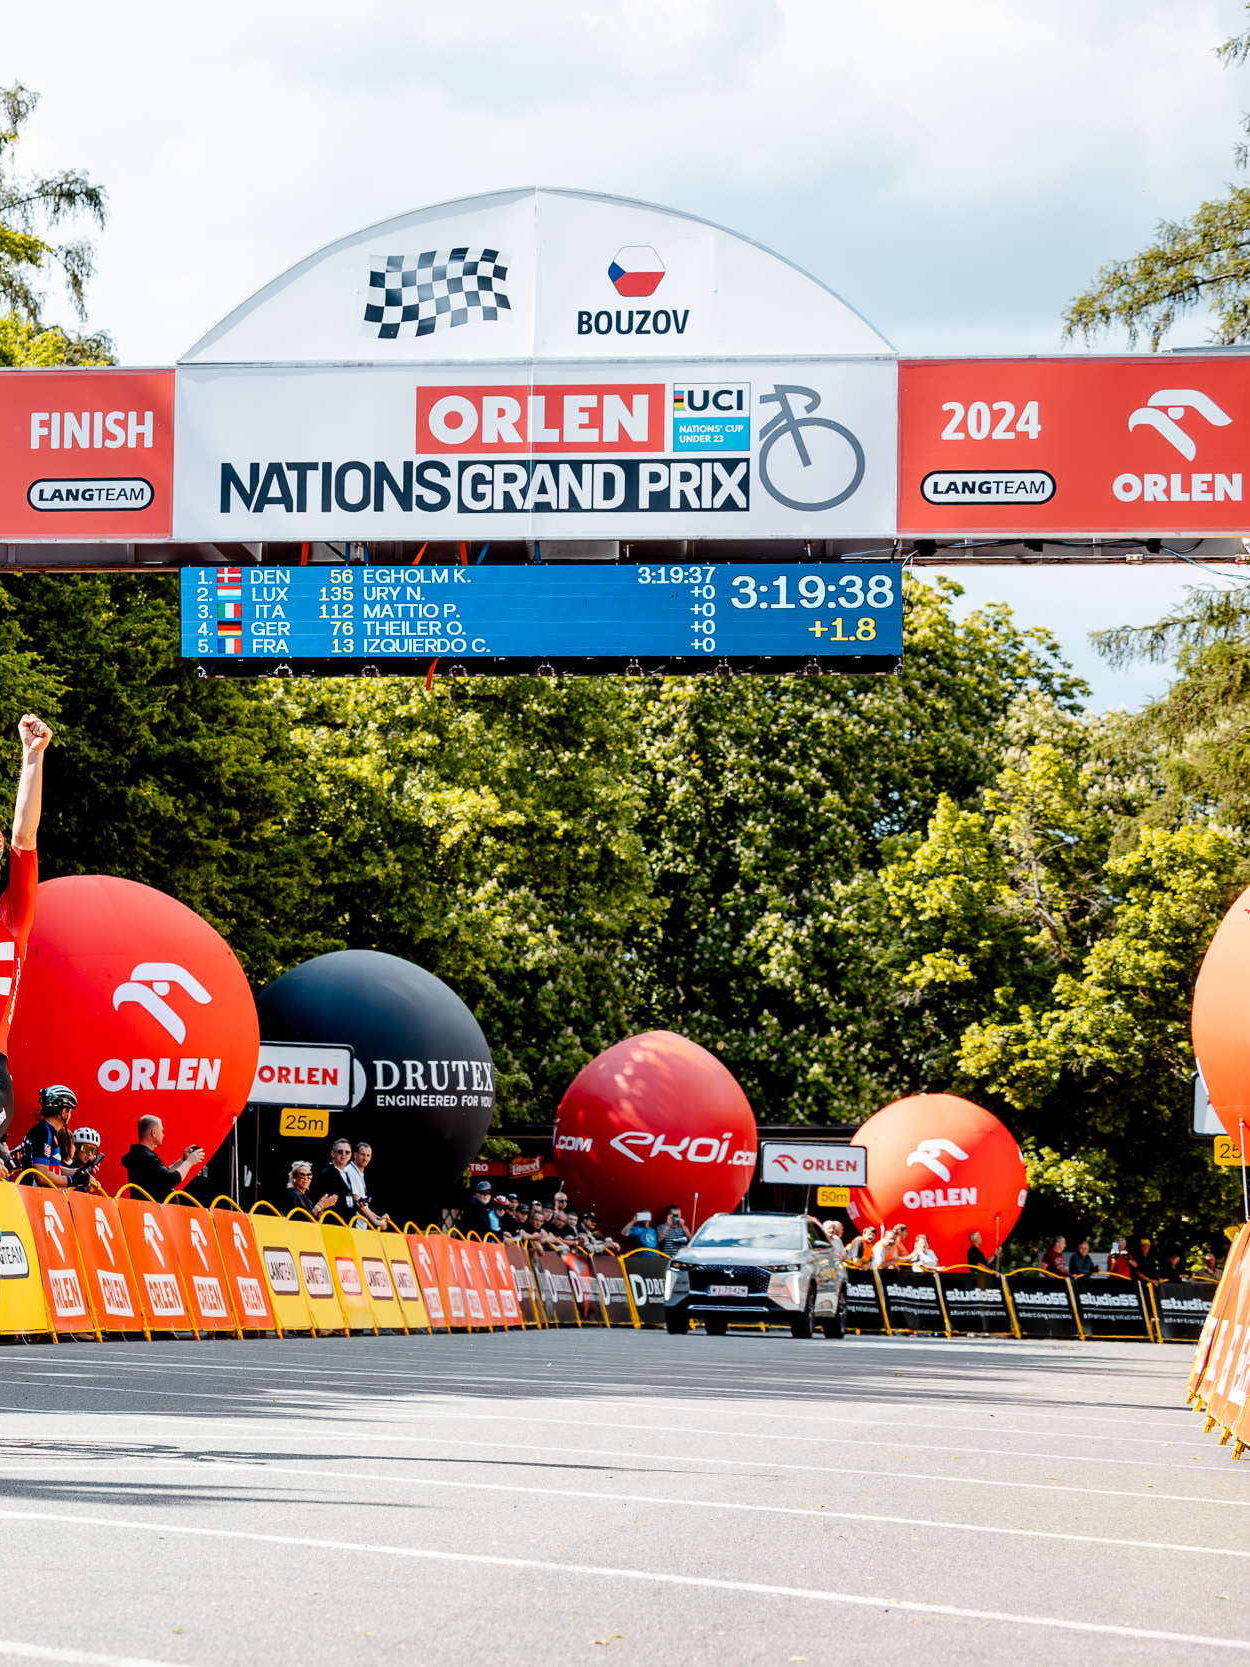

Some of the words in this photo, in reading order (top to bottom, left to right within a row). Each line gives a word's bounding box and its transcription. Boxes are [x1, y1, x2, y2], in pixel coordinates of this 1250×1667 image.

[577, 309, 689, 335] BOUZOV
[687, 389, 743, 411] UCI
[428, 394, 649, 445] ORLEN
[725, 424, 744, 432] CUP
[941, 400, 1042, 440] 2024
[30, 410, 154, 449] FINISH
[679, 435, 711, 443] UNDER
[713, 434, 724, 443] 23
[38, 487, 144, 502] LANGTEAM
[220, 459, 451, 514] NATIONS
[461, 463, 626, 511] GRAND
[638, 461, 748, 509] PRIX
[932, 480, 1045, 494] LANGTEAM
[1112, 472, 1243, 502] ORLEN
[197, 570, 213, 584] 1.
[250, 569, 290, 584] DEN
[330, 569, 354, 584] 56
[363, 569, 448, 584] EGHOLM
[453, 569, 472, 583] K.
[637, 566, 716, 584] 3:19:37
[197, 587, 213, 601] 2.
[252, 587, 289, 601] LUX
[319, 586, 354, 601] 135
[363, 586, 401, 601] URY
[406, 586, 425, 600] N.
[690, 584, 716, 600] +0
[730, 574, 894, 609] 3:19:38
[197, 604, 213, 619] 3.
[255, 604, 286, 618] ITA
[319, 604, 354, 618] 112
[363, 603, 439, 618] MATTIO
[443, 603, 461, 618] P.
[690, 602, 716, 617] +0
[197, 621, 213, 636] 4.
[251, 621, 291, 636] GER
[330, 621, 354, 636] 76
[363, 621, 442, 636] THEILER
[446, 621, 467, 636] O.
[690, 619, 716, 635] +0
[808, 617, 877, 641] +1.8
[197, 638, 213, 653] 5.
[252, 639, 289, 653] FRA
[331, 638, 354, 653] 13
[363, 638, 467, 653] IZQUIERDO
[471, 638, 491, 653] C.
[690, 637, 716, 652] +0
[97, 1057, 222, 1093] ORLEN
[258, 1065, 338, 1086] ORLEN
[373, 1060, 493, 1092] DRUTEX
[376, 1094, 457, 1107] ENGINEERED
[461, 1094, 479, 1107] FOR
[480, 1095, 493, 1108] YOU
[285, 1113, 324, 1132] 25m
[1219, 1143, 1242, 1159] 25
[802, 1159, 857, 1172] ORLEN
[821, 1191, 847, 1202] 50m
[902, 1187, 977, 1209] ORLEN
[148, 1280, 181, 1309] ORLEN
[646, 1278, 665, 1295] DRU
[886, 1283, 937, 1300] studio55
[945, 1288, 1003, 1302] studio55
[1013, 1290, 1069, 1306] studio55
[1079, 1292, 1140, 1307] studio55
